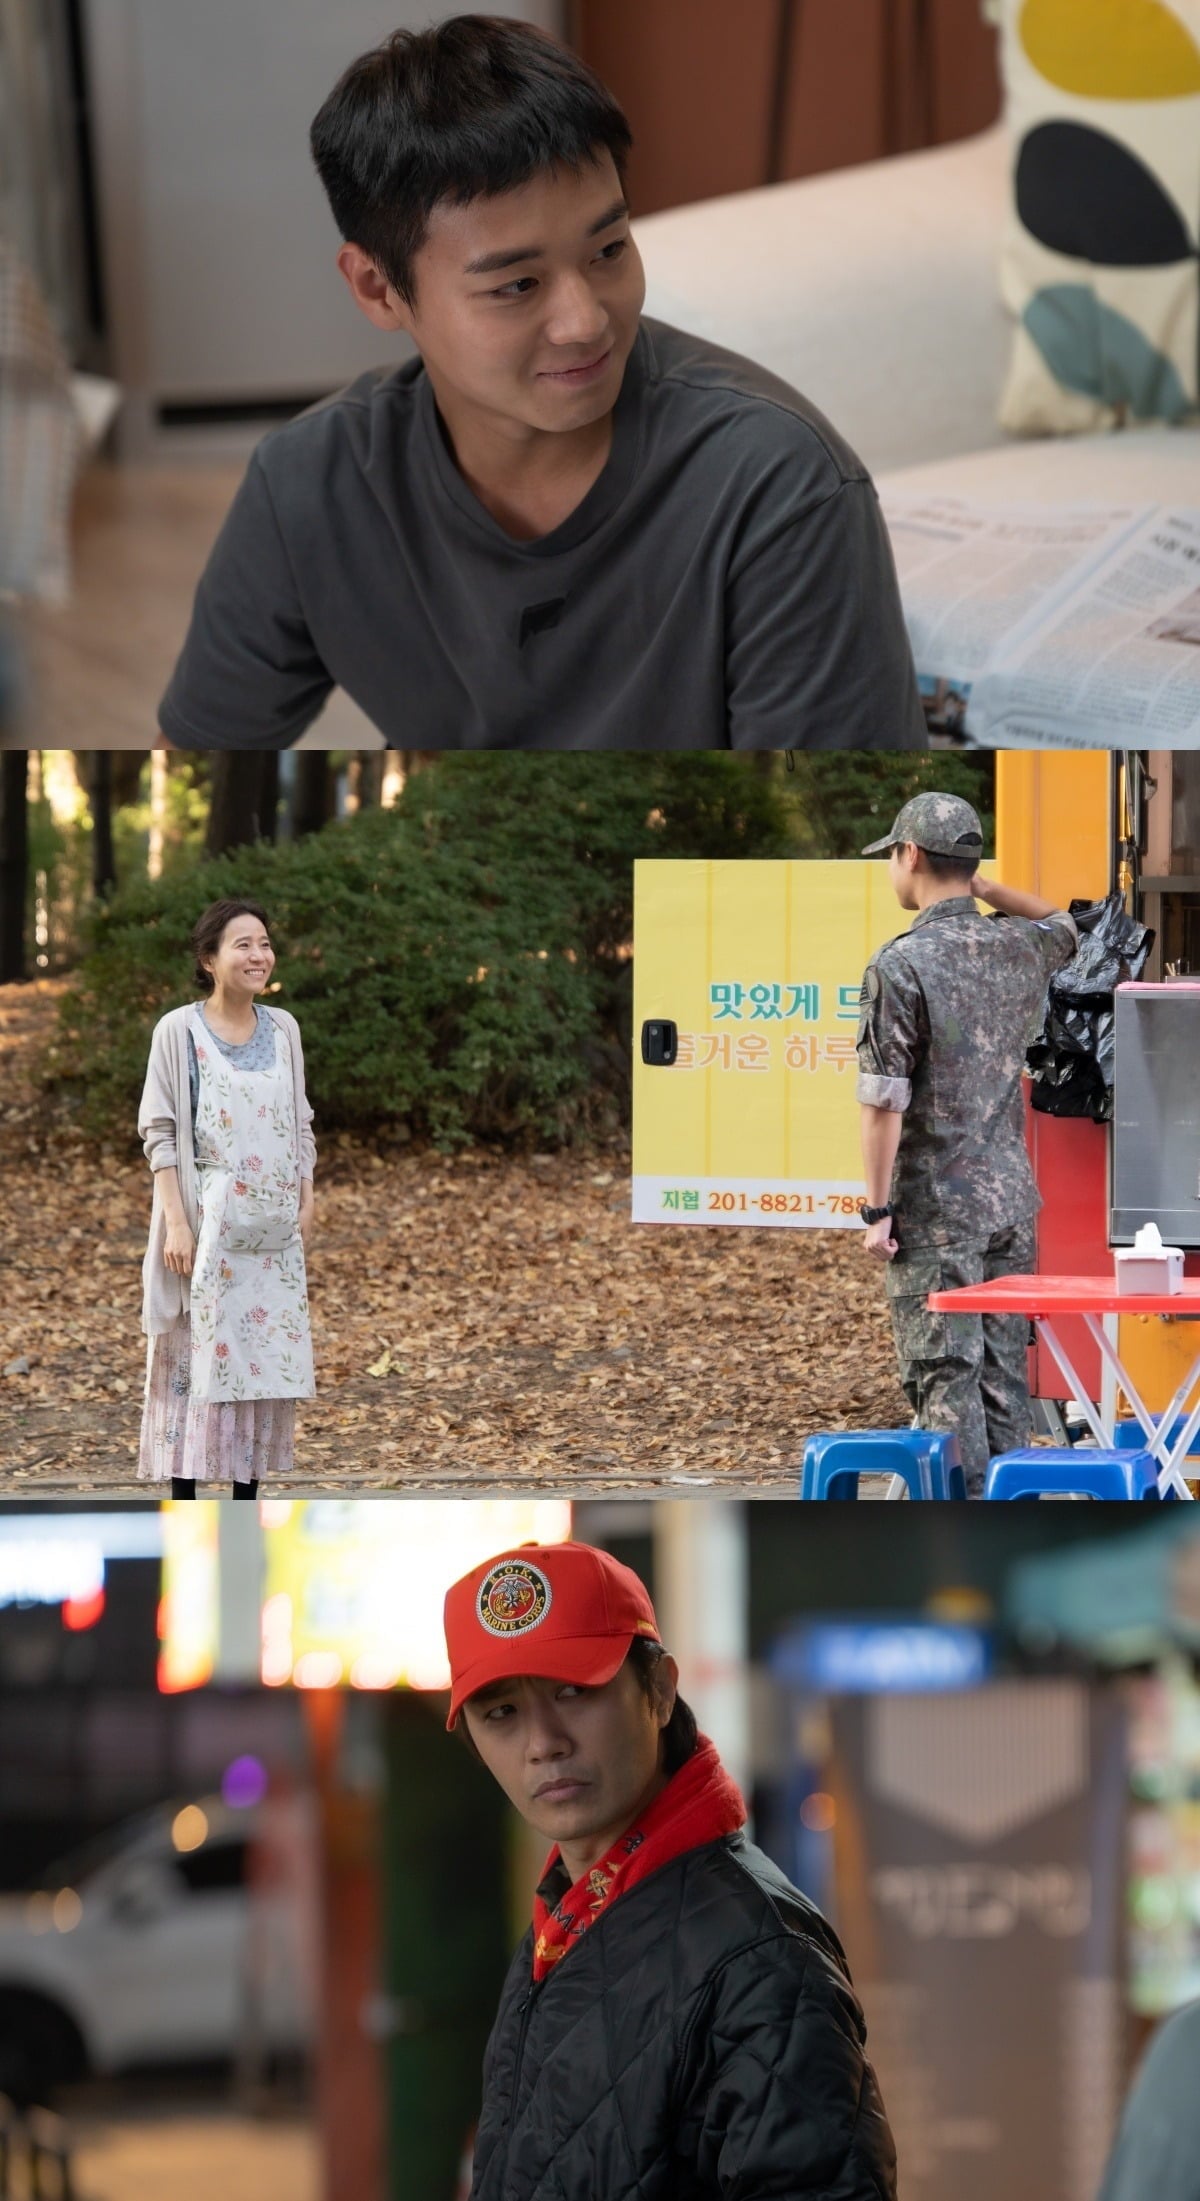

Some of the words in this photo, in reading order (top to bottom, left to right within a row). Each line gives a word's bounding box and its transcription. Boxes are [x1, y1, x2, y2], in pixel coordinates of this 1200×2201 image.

[710, 983, 820, 1021] 맛있게
[836, 985, 861, 1019] 드
[785, 1034, 858, 1072] 하루
[661, 1189, 700, 1211] 지협
[482, 1607, 516, 1631] MARINE
[518, 1596, 545, 1627] CORPS
